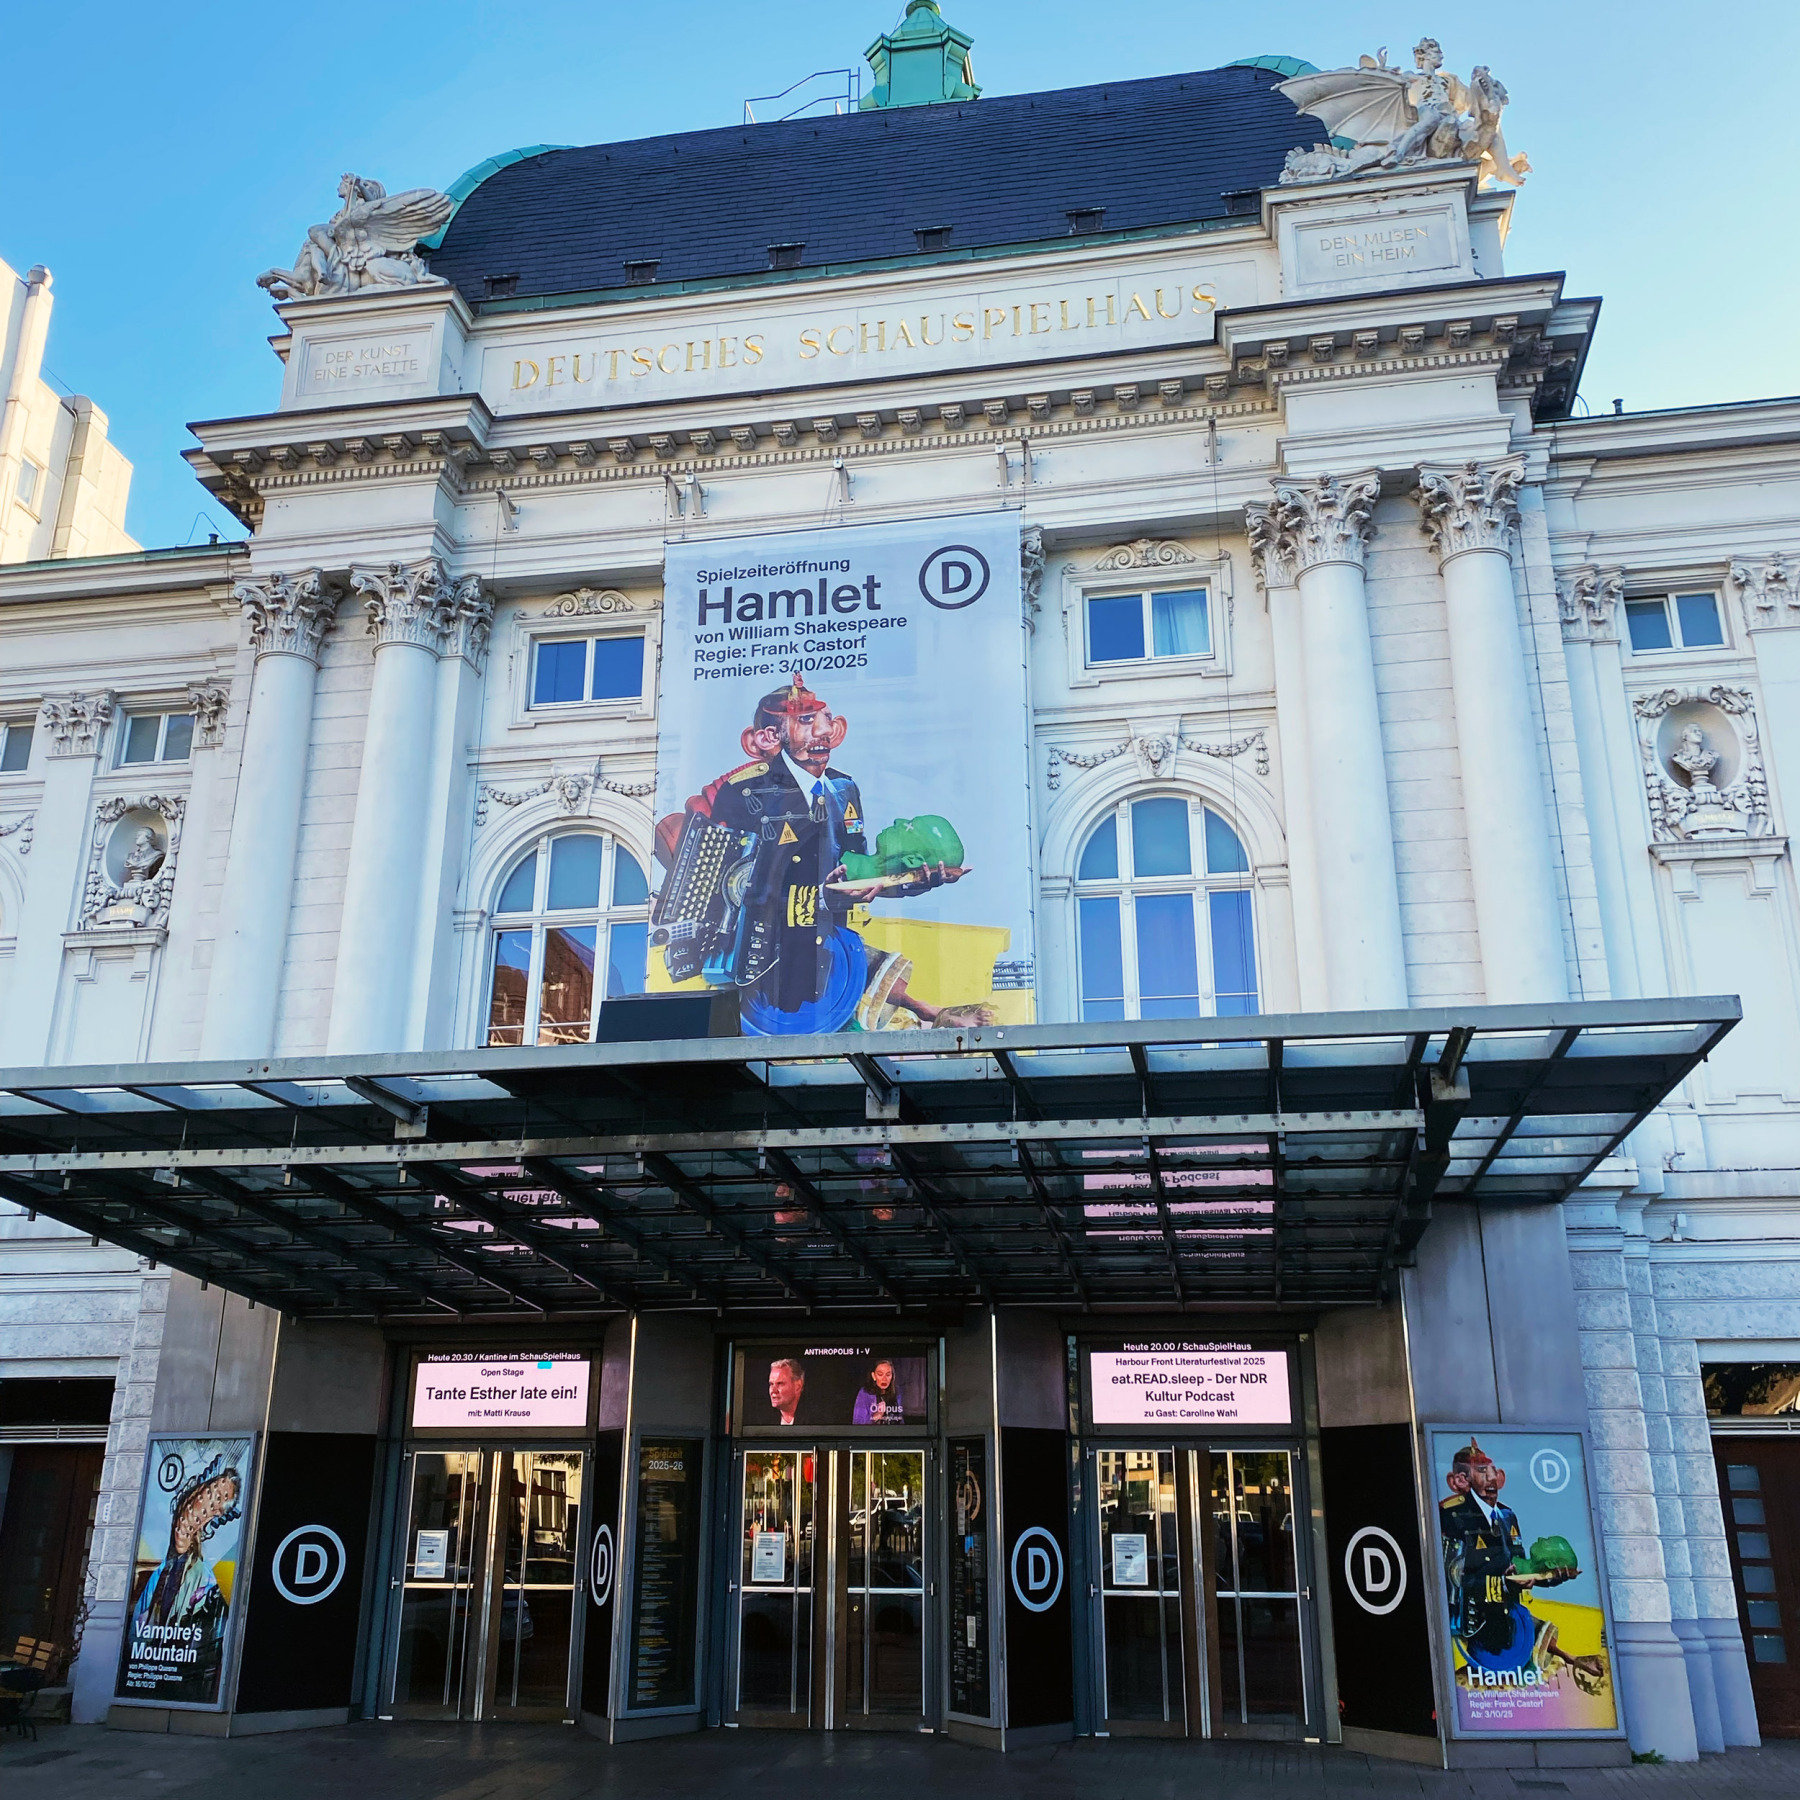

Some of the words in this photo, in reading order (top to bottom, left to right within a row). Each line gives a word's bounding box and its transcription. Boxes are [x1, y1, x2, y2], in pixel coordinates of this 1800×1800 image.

[1320, 234, 1357, 251] DEN
[1364, 226, 1429, 247] MUSEN
[1335, 251, 1364, 267] EIN
[1371, 246, 1416, 262] HEIM
[325, 350, 354, 364] DER
[360, 344, 411, 361] KUNST
[511, 334, 764, 391] DEUTSCHES
[315, 367, 347, 381] EINE
[353, 359, 418, 377] STAETTE
[696, 559, 850, 584] Spielzeiteröffnung
[698, 575, 881, 626] Hamlet
[694, 632, 724, 644] von
[728, 624, 789, 641] William
[794, 617, 907, 636] Shakespeare
[694, 647, 746, 664] Regie:
[751, 641, 799, 657] Frank
[803, 635, 867, 653] Castorf
[693, 661, 774, 681] Premiere:
[779, 653, 868, 674] 3/10/2025
[428, 1354, 451, 1362] Heute
[451, 1353, 473, 1361] 20.30
[473, 1353, 479, 1361] /
[479, 1353, 508, 1361] Kantine
[520, 1352, 581, 1361] SchauSpielHaus
[804, 1348, 854, 1356] ANTHROPOLIS
[1123, 1343, 1149, 1351] Heute
[1150, 1343, 1175, 1351] 20.00
[1177, 1342, 1181, 1351] /
[1182, 1342, 1252, 1352] SchauSpielHaus
[1115, 1358, 1150, 1366] Harbour
[1151, 1358, 1174, 1366] Front
[1175, 1357, 1241, 1366] Literaturfestival
[481, 1369, 501, 1377] Open
[502, 1368, 524, 1377] Stage
[1111, 1373, 1204, 1386] eat.READ.sleep
[1215, 1373, 1237, 1384] Der
[1240, 1373, 1268, 1384] NDR
[426, 1387, 467, 1400] Tante
[470, 1386, 517, 1400] Esther
[520, 1386, 547, 1399] late
[551, 1386, 578, 1399] ein!
[1145, 1391, 1183, 1402] Kultur
[1185, 1390, 1235, 1402] Podcast
[1155, 1410, 1178, 1418] Gast:
[1179, 1409, 1215, 1418] Caroline
[1216, 1409, 1238, 1418] Wahl
[648, 1460, 684, 1471] 2025-26
[135, 1620, 203, 1642] Vampire's
[130, 1641, 197, 1664] Mountain
[1467, 1665, 1544, 1686] Hamlet
[1469, 1700, 1493, 1709] Regie:
[1494, 1700, 1515, 1708] Frank
[1517, 1699, 1544, 1708] Castorf
[1471, 1710, 1483, 1718] Ab:
[1484, 1710, 1513, 1718] 3/10/25
